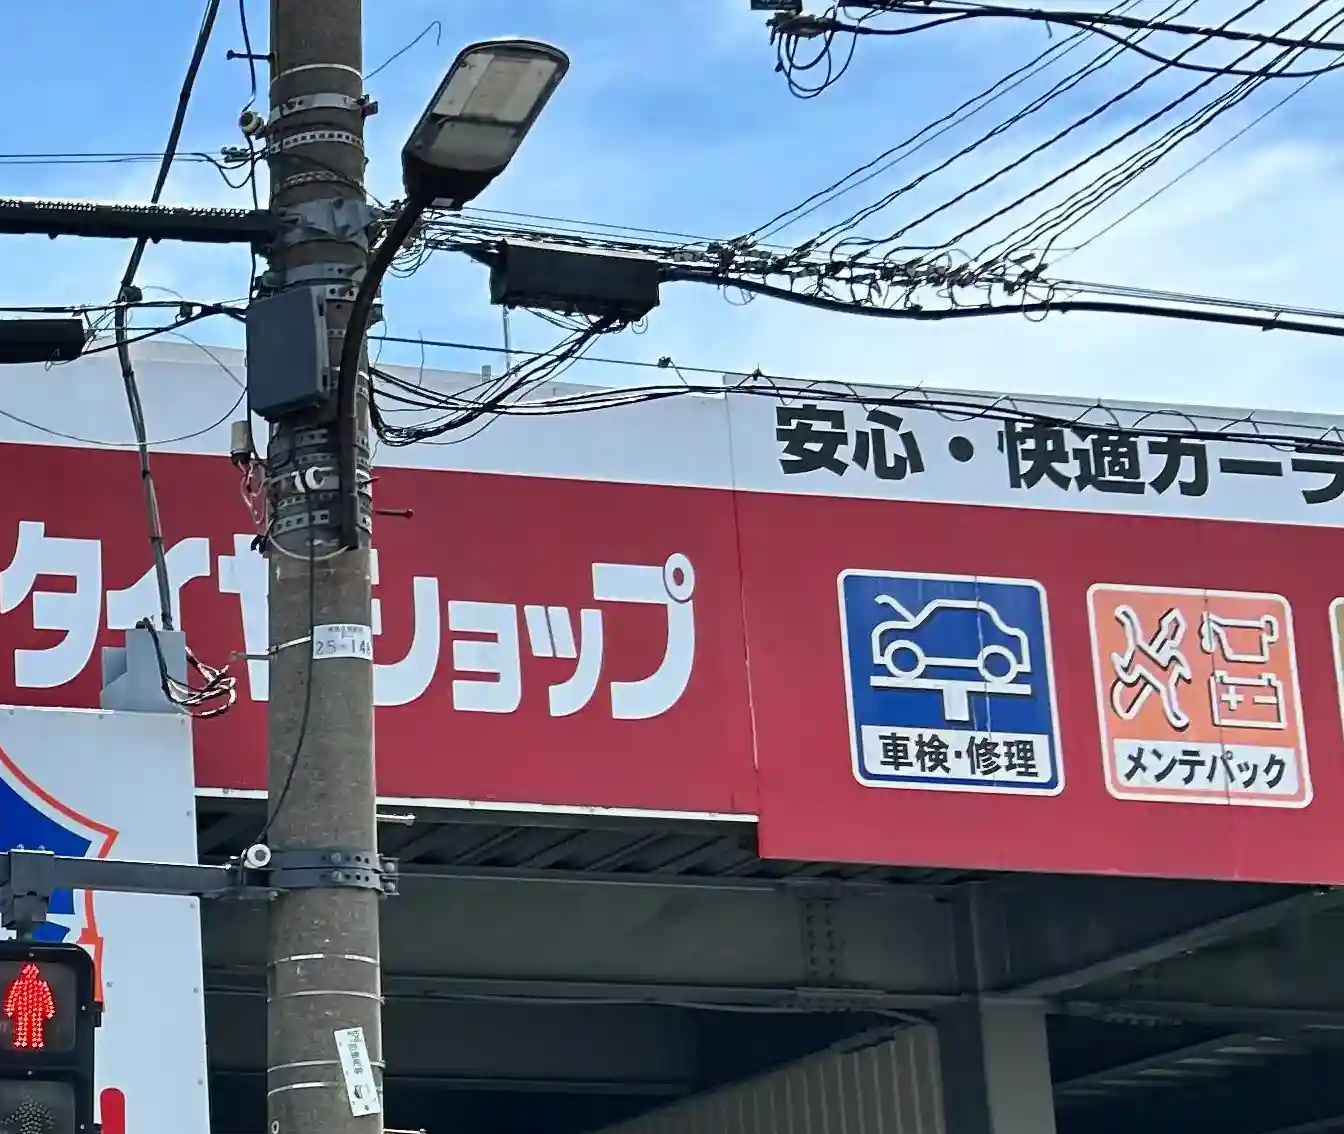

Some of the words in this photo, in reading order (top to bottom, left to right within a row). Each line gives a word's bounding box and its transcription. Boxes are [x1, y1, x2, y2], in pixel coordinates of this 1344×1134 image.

[878, 733, 1040, 778] 車検・修理
[1123, 747, 1287, 789] メンテパック
